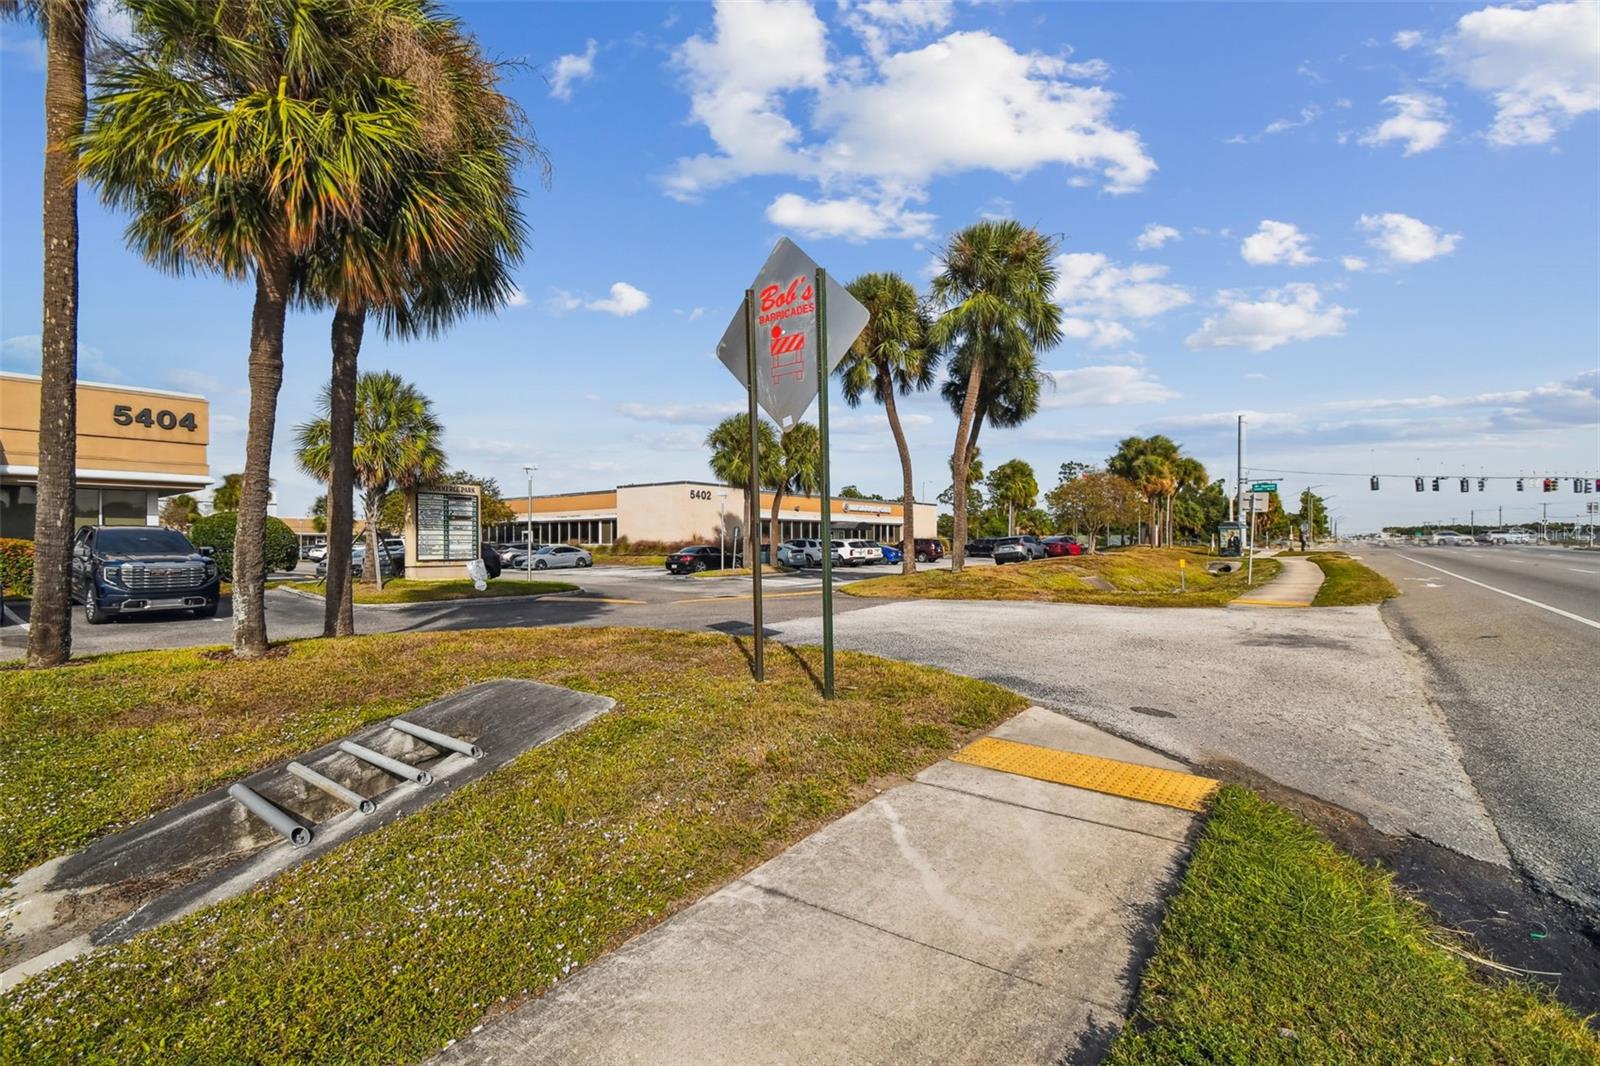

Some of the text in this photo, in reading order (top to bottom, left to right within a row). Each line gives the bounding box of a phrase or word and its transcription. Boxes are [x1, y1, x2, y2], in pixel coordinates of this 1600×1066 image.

[759, 275, 814, 312] Bob's
[759, 303, 815, 325] BARRICADES
[113, 405, 197, 432] 5404
[690, 490, 712, 500] 5402
